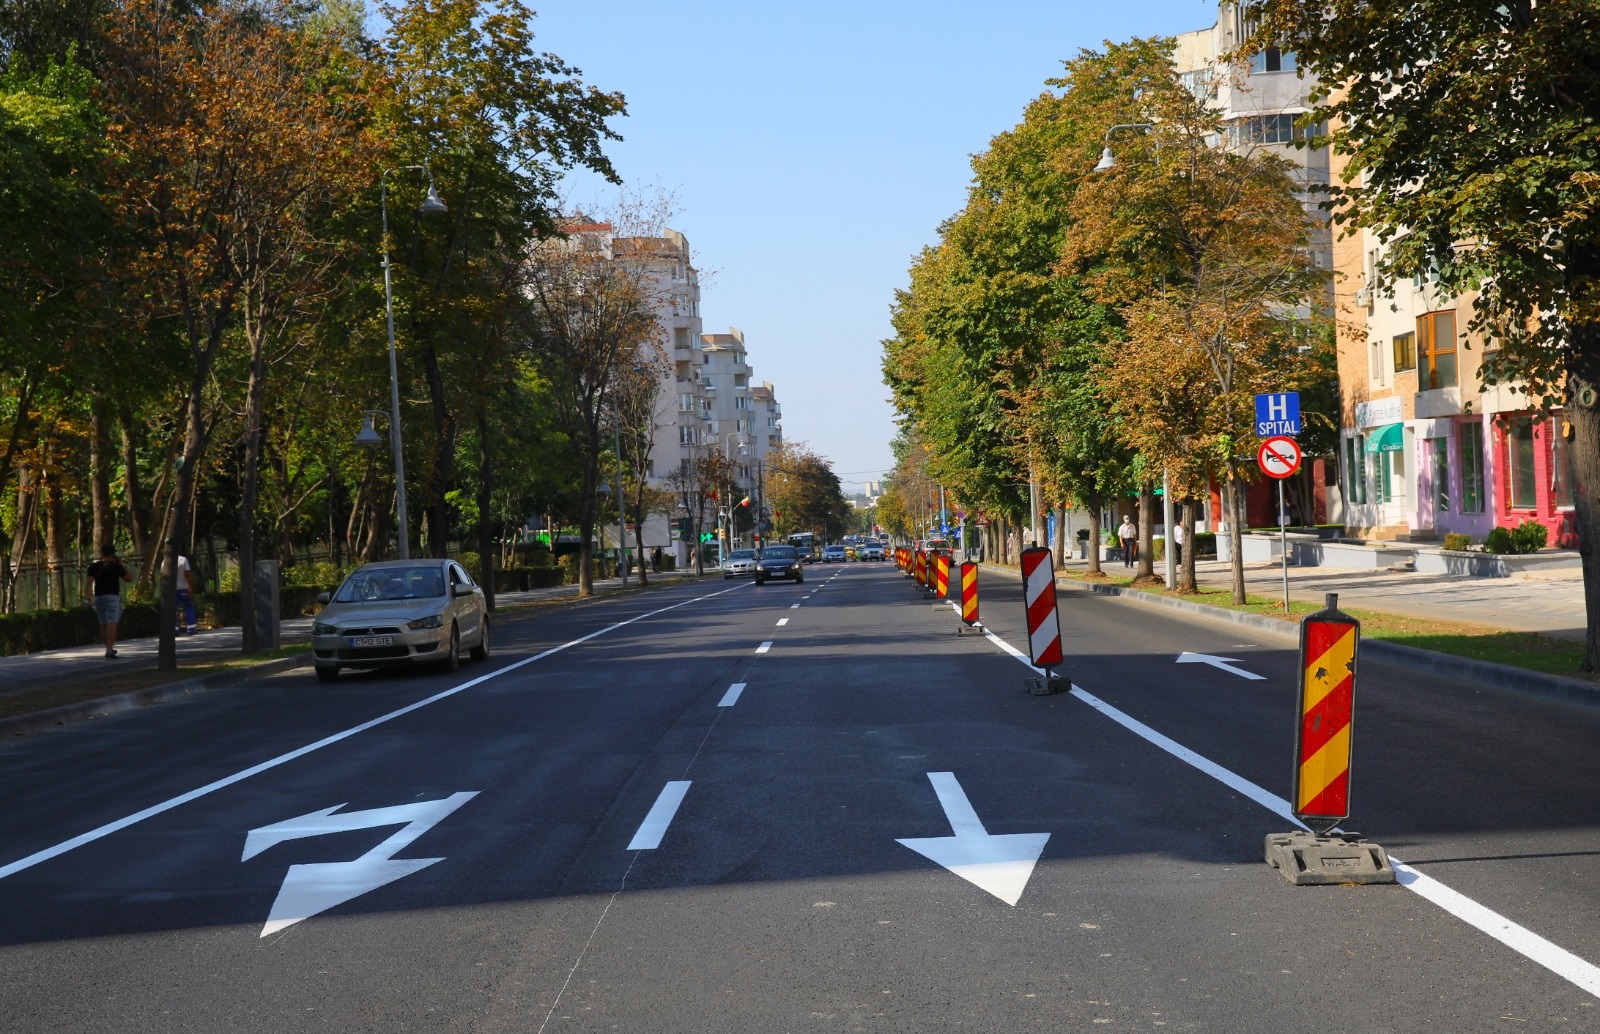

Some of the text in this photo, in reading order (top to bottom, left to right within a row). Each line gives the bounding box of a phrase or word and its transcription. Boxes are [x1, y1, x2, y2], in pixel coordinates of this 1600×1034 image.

[1268, 395, 1287, 420] H
[1259, 421, 1298, 435] SPITAL
[376, 637, 391, 645] STE
